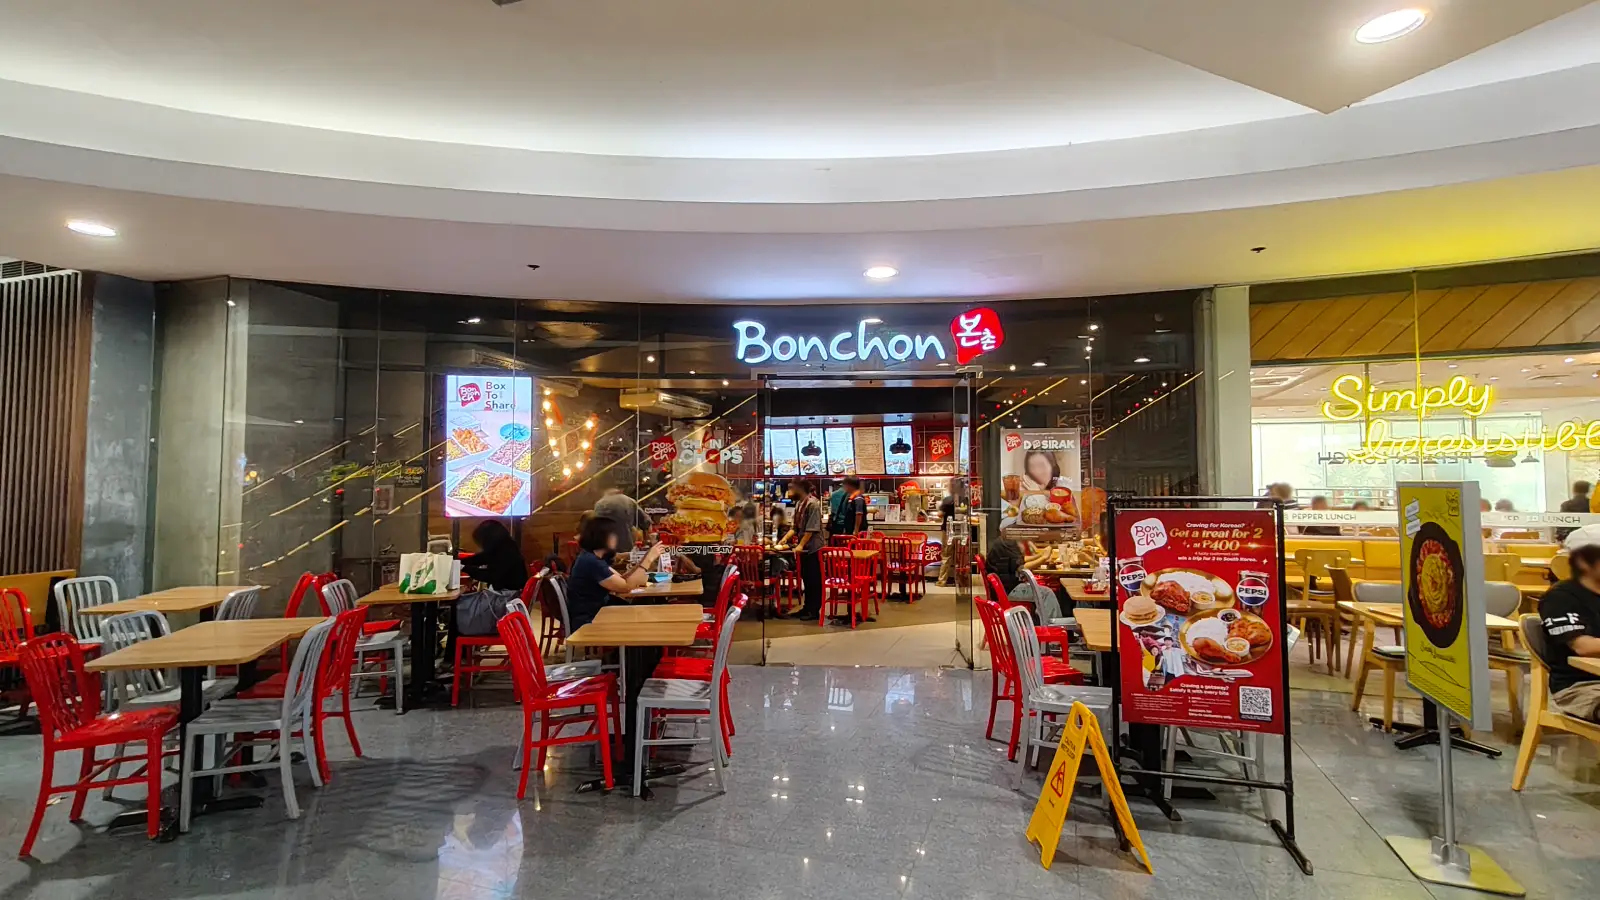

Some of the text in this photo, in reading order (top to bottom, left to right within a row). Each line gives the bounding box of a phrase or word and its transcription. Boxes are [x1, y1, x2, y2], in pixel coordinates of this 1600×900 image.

[734, 319, 946, 363] Bonchon
[485, 381, 506, 390] Box
[485, 391, 498, 399] To
[1323, 375, 1492, 420] Simply
[1134, 526, 1159, 538] Bon
[1169, 527, 1263, 539] Get a treat for 2
[1238, 587, 1267, 596] PEPSI
